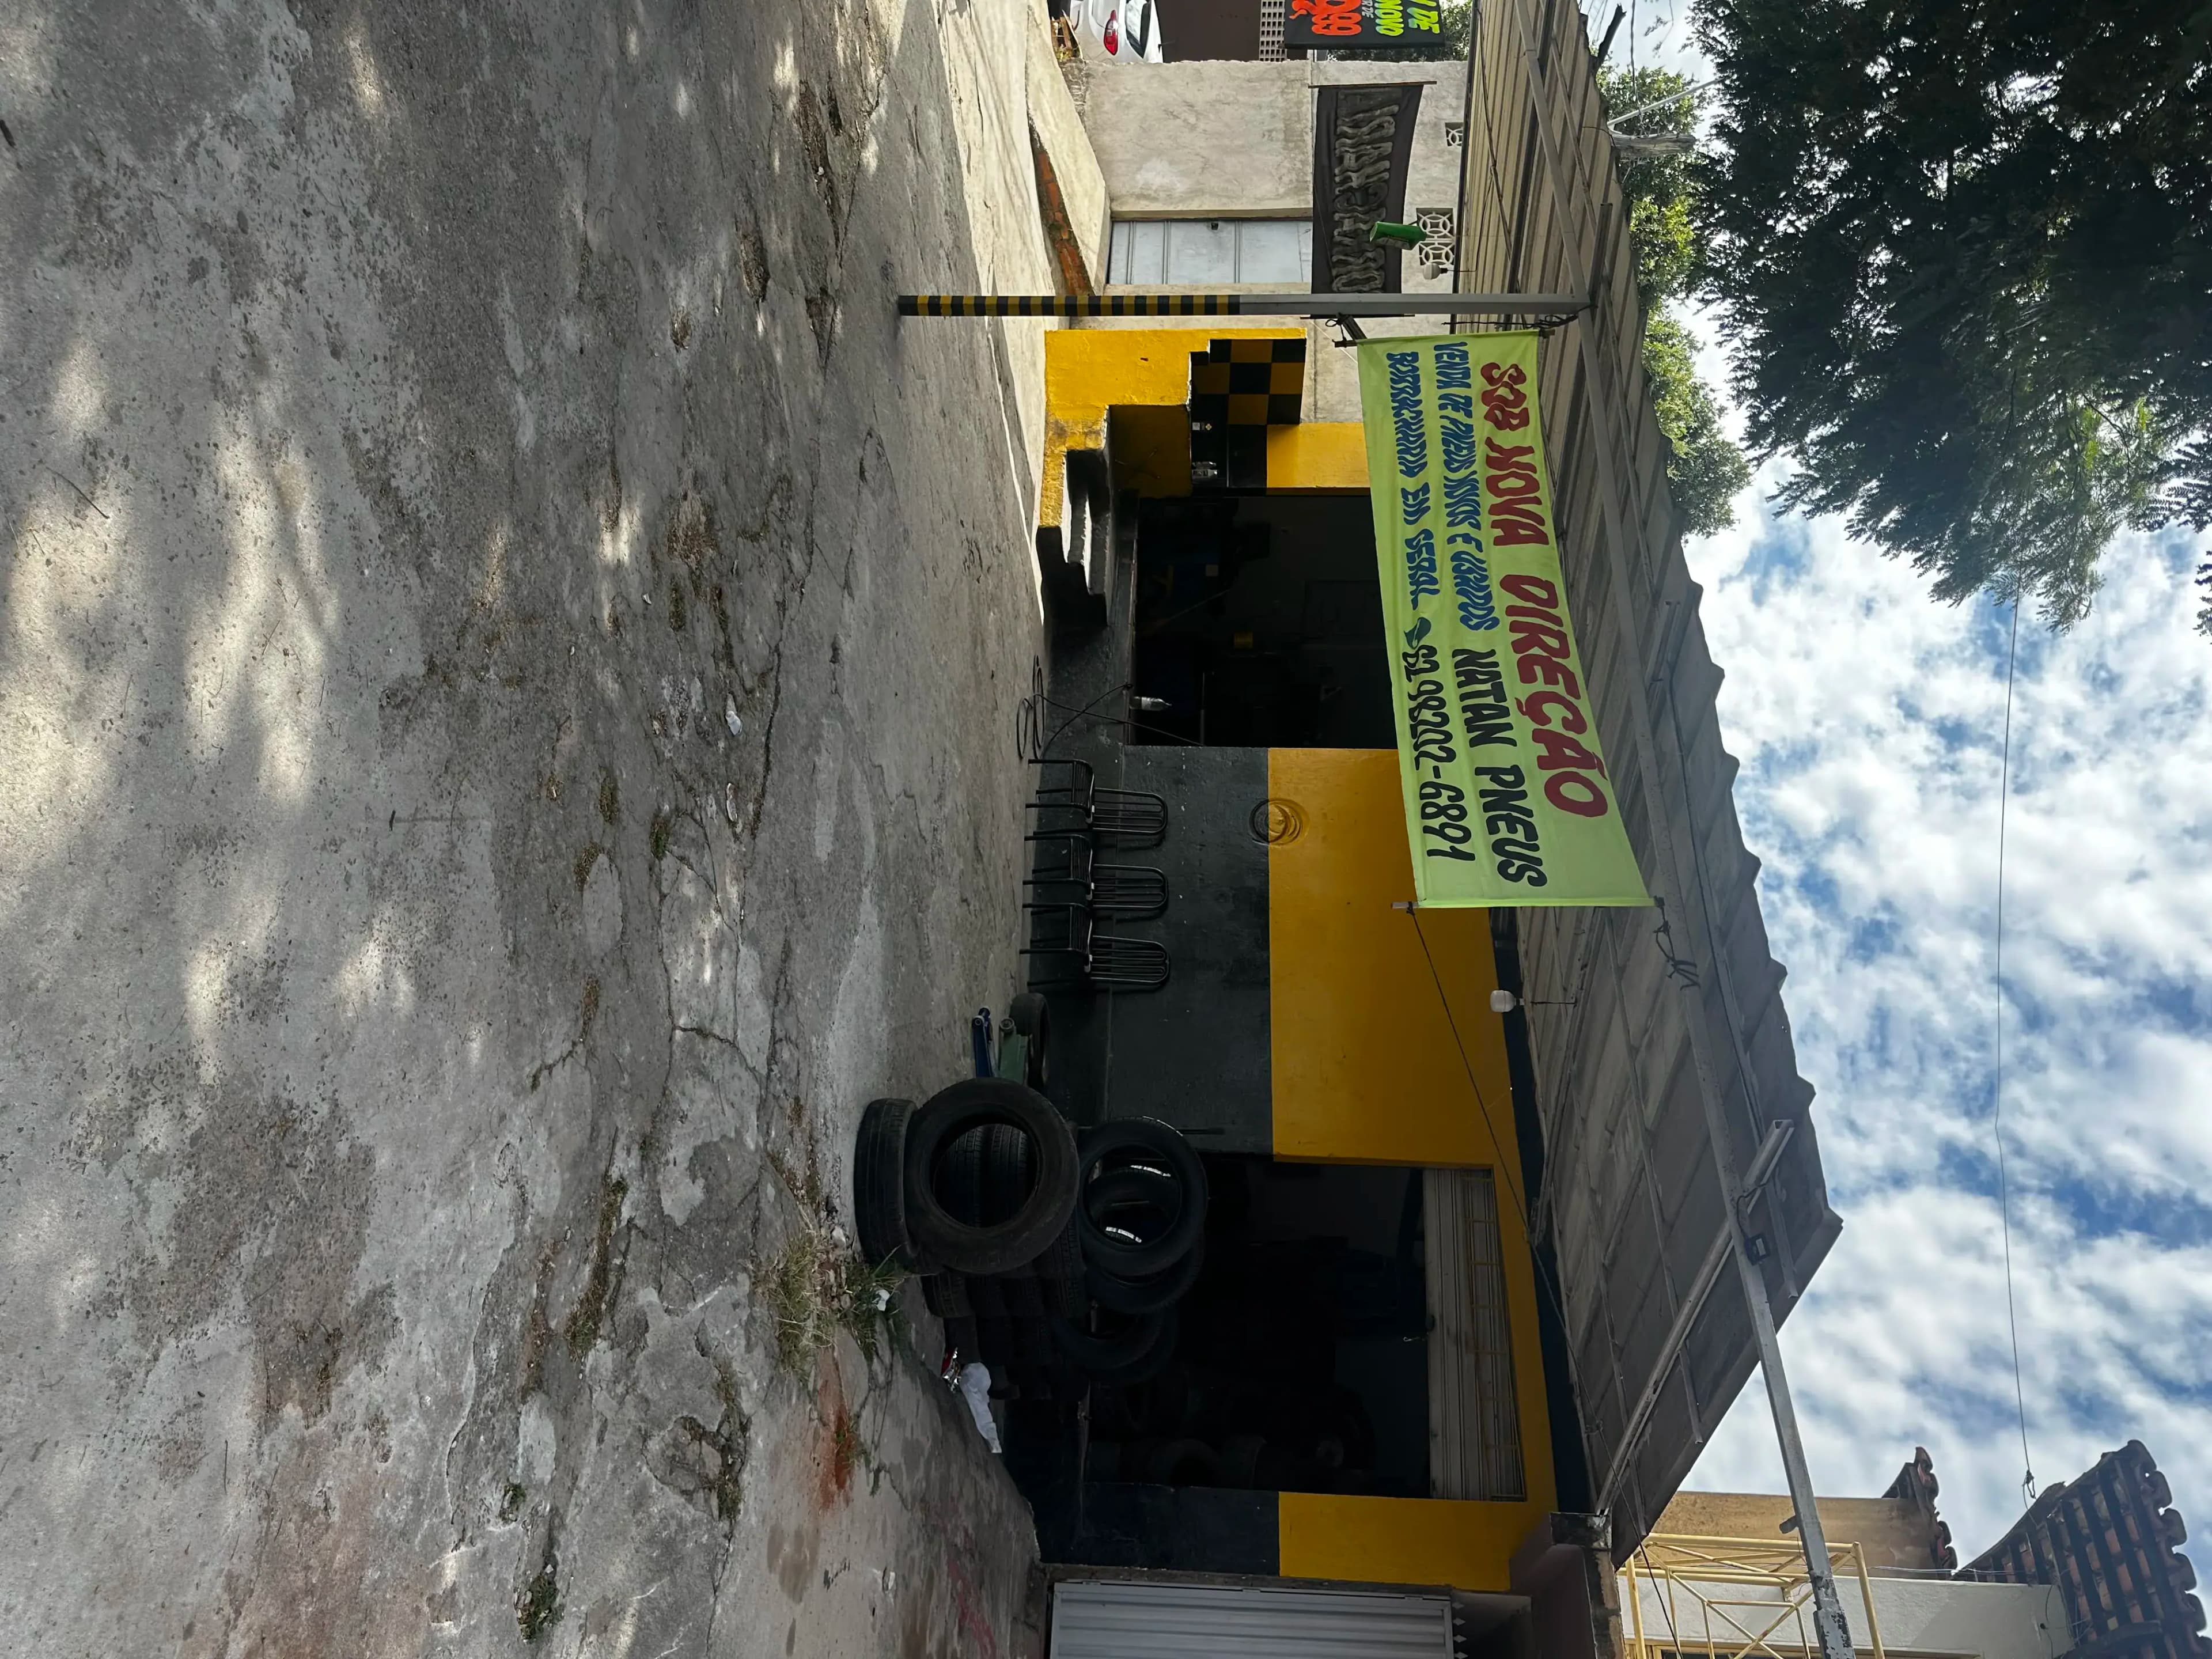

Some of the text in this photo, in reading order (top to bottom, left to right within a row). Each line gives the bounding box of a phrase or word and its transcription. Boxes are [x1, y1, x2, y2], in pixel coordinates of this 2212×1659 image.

[1361, 7, 1374, 18] DE
[1407, 7, 1440, 34] DE
[1386, 351, 1440, 611] BORRACHARIA EM GERAL
[1434, 342, 1501, 631] VENDA DE PNEUS NOVOS E USADOS
[1481, 362, 1608, 817] SOB NOVA DIREÇÃO
[1402, 645, 1476, 861] 62 98202-6891
[1452, 648, 1548, 887] NATAN PNEUS
